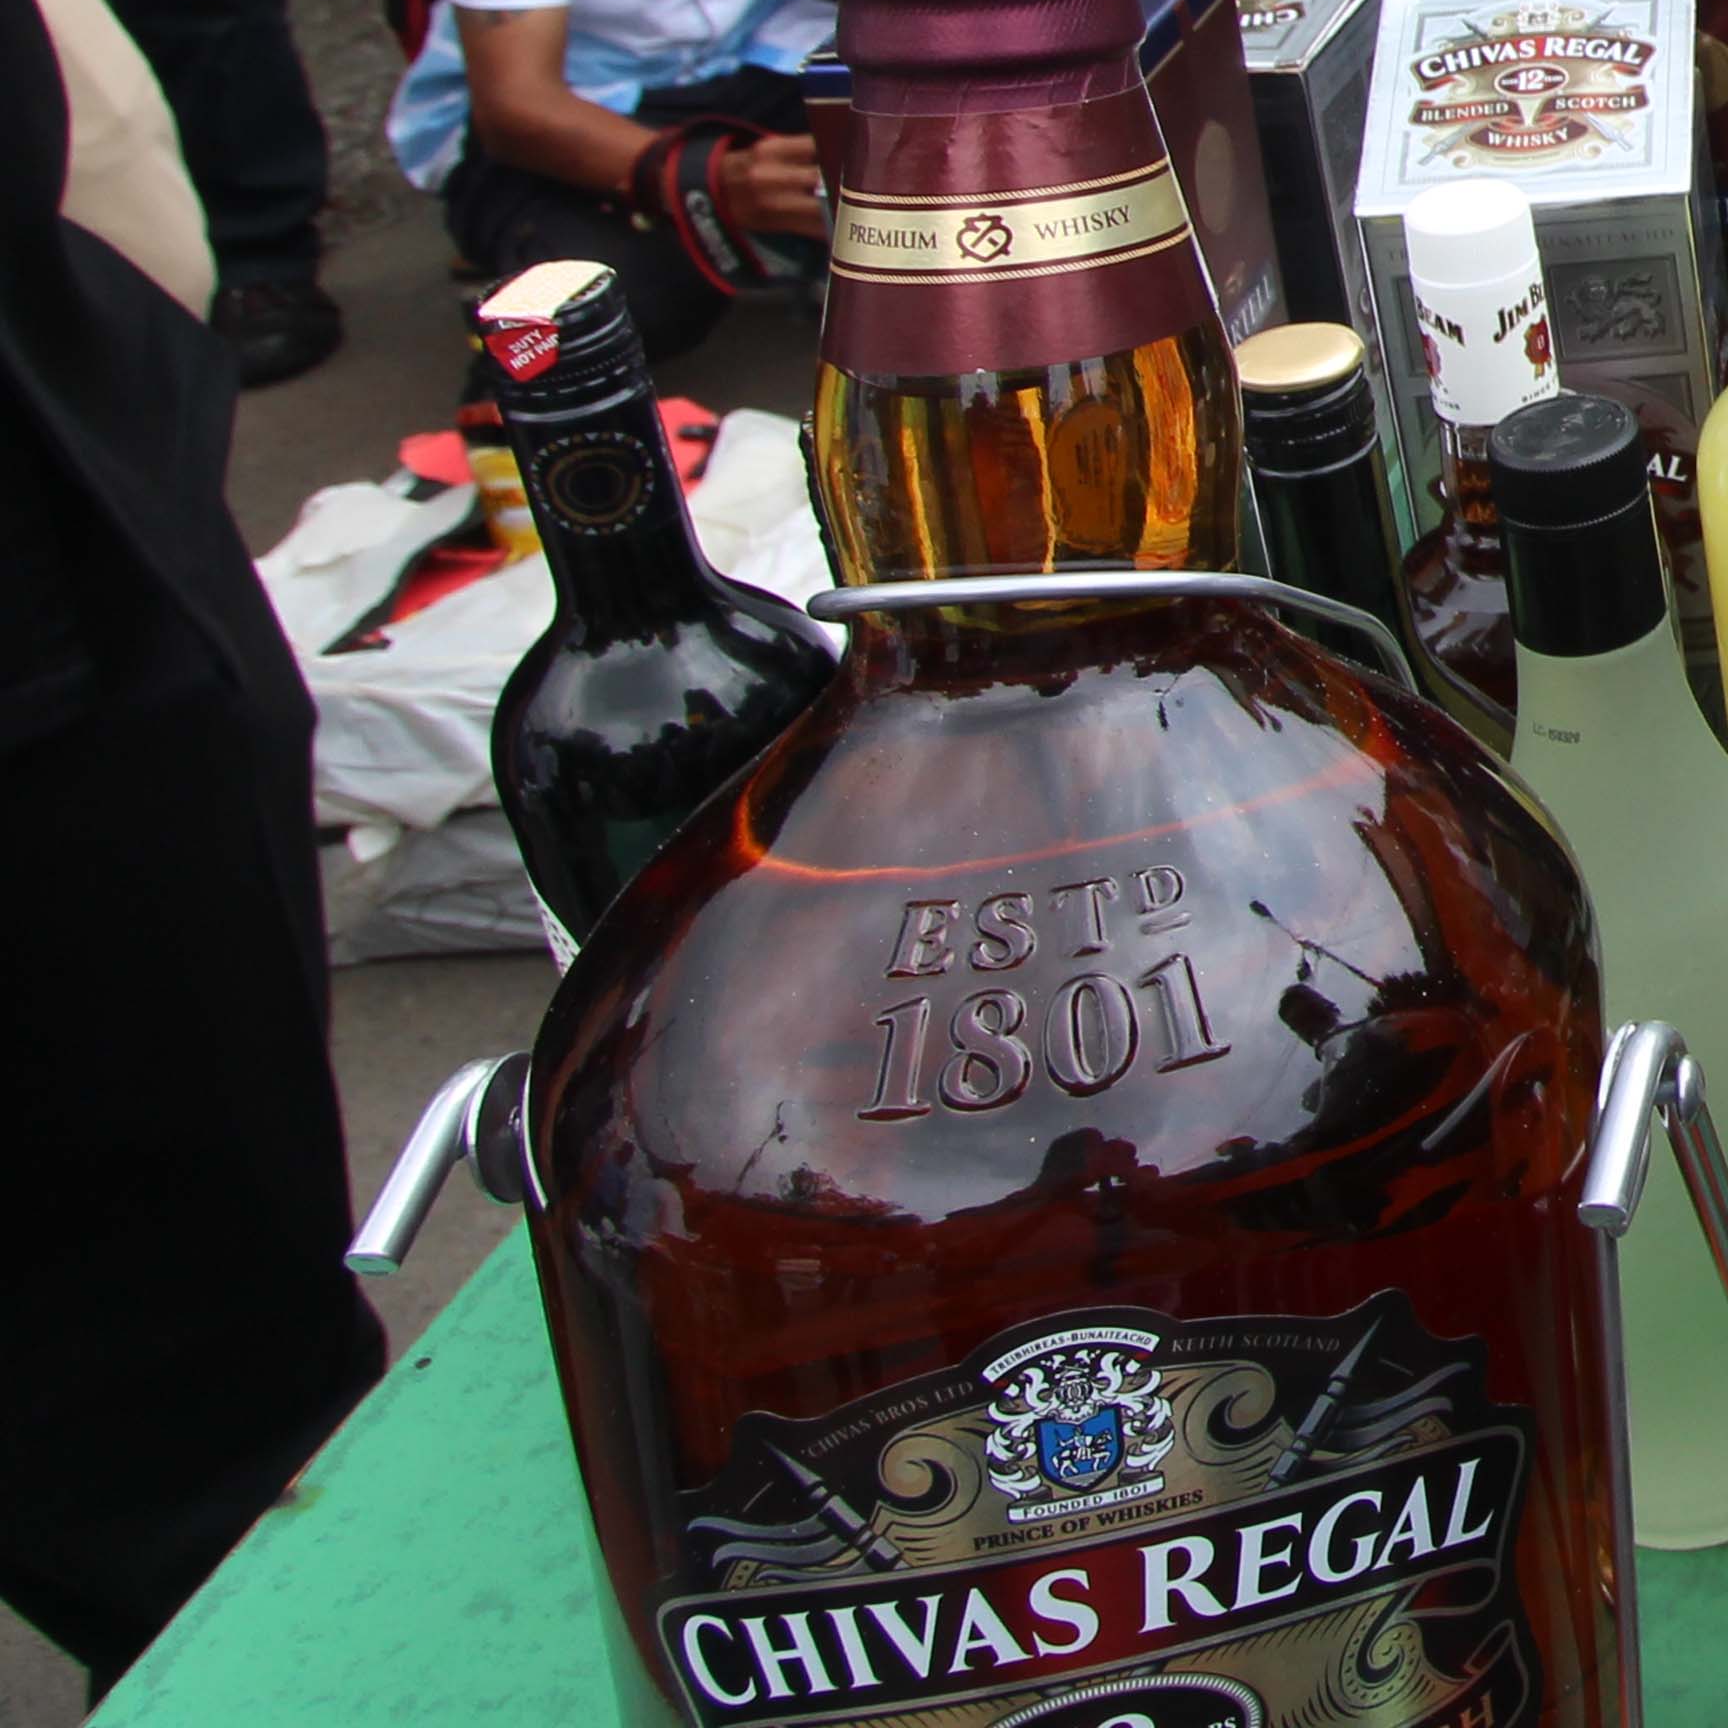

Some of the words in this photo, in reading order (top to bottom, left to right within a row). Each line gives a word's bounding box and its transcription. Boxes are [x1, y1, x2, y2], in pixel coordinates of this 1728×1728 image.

[1420, 39, 1537, 78] CHIVAS
[1543, 37, 1646, 65] REGAL
[1517, 69, 1545, 91] 12
[1421, 101, 1510, 122] BLENDED
[1555, 95, 1637, 110] SCOTCH
[1487, 128, 1570, 148] WHISKY
[848, 222, 938, 251] PREMIUM
[1034, 205, 1132, 242] WHISKY
[1493, 295, 1529, 344] JIM
[507, 328, 543, 354] DUTY
[509, 350, 537, 371] NOT
[856, 952, 1232, 1123] 1801
[1171, 1335, 1234, 1354] KEITH
[1240, 1334, 1342, 1353] SCOTLAND
[806, 1420, 874, 1460] CHIVAS
[875, 1392, 930, 1427] BROS
[933, 1379, 975, 1404] LTD
[1023, 1495, 1103, 1518] FOUNDED
[1113, 1484, 1149, 1501] 1801
[973, 1520, 1055, 1551] PRINCE
[1061, 1515, 1091, 1536] OF
[1095, 1489, 1205, 1527] WHISKIES
[682, 1568, 1101, 1708] CHIVAS
[1138, 1457, 1495, 1634] REGAL
